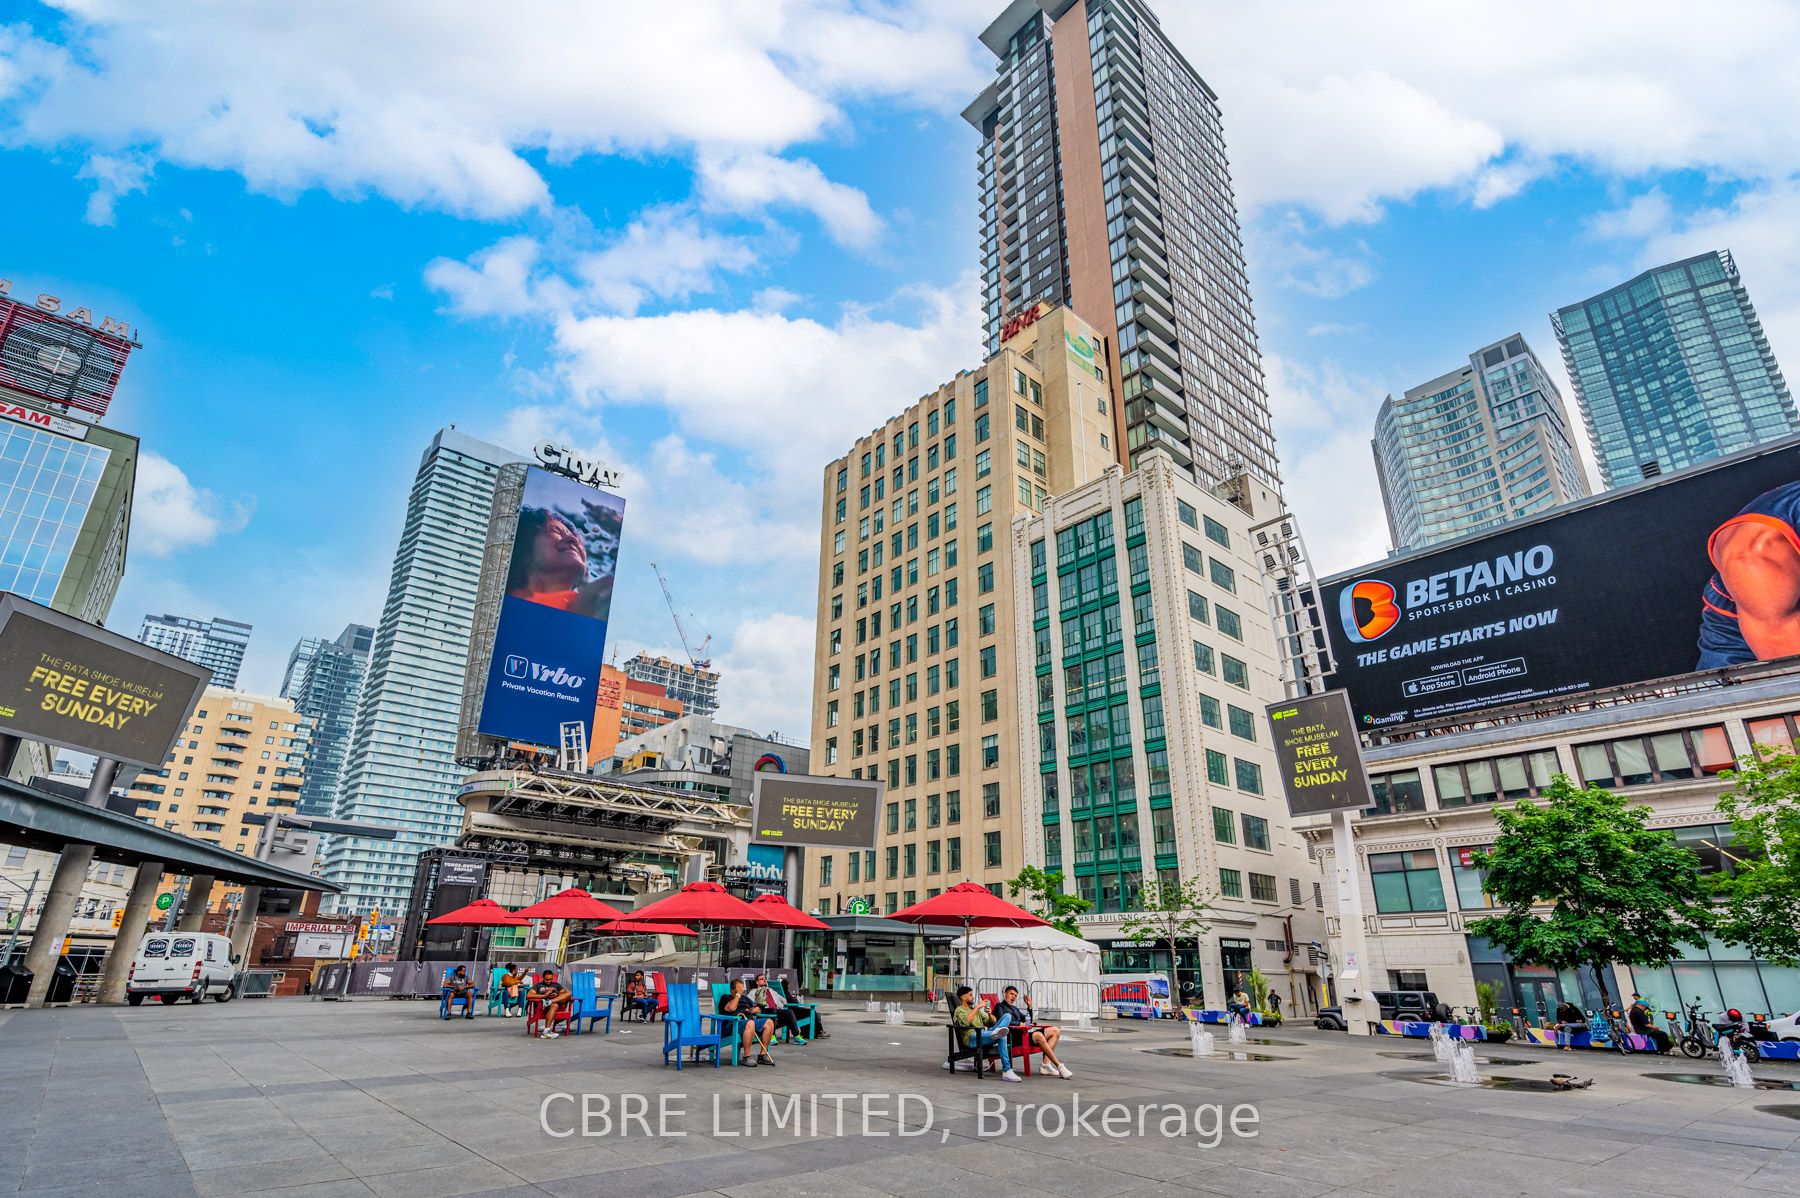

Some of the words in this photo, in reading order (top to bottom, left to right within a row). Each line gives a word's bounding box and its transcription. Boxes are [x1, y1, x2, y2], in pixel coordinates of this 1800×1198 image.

[35, 293, 130, 339] SAM
[534, 439, 624, 488] Citytv
[1406, 544, 1554, 609] BETANO
[1408, 590, 1491, 621] SPORTSBOOK
[1505, 575, 1557, 596] CASINO
[1357, 649, 1387, 668] THE
[1389, 637, 1437, 660] GAME
[1439, 621, 1505, 649] STARTS
[1509, 608, 1559, 633] NOW
[531, 662, 584, 688] Vrbo
[1430, 660, 1461, 671] DOWNLOAD
[1468, 672, 1496, 682] Android
[1497, 666, 1521, 676] Phone
[40, 653, 62, 667] THE
[63, 662, 89, 677] BATA
[91, 670, 120, 687] SHOE
[121, 680, 163, 700] MUSEUM
[1421, 683, 1436, 692] App
[1436, 679, 1456, 688] Store
[28, 665, 90, 697] FREE
[88, 684, 158, 717] EVERY
[502, 680, 525, 692] Private
[527, 686, 556, 698] Vacation
[556, 693, 580, 702] Rentals
[40, 693, 132, 730] SUNDAY
[1284, 736, 1303, 746] SHOE
[1304, 730, 1339, 742] MUSEUM
[1291, 727, 1305, 736] THE
[1305, 723, 1326, 733] BATA
[1296, 742, 1331, 758] FREE
[1295, 755, 1338, 774] EVERY
[1293, 769, 1348, 788] SUNDAY
[782, 805, 814, 817] FREE
[816, 807, 858, 820] EVERY
[793, 818, 845, 831] SUNDAY
[286, 923, 333, 932] IMPERIAL
